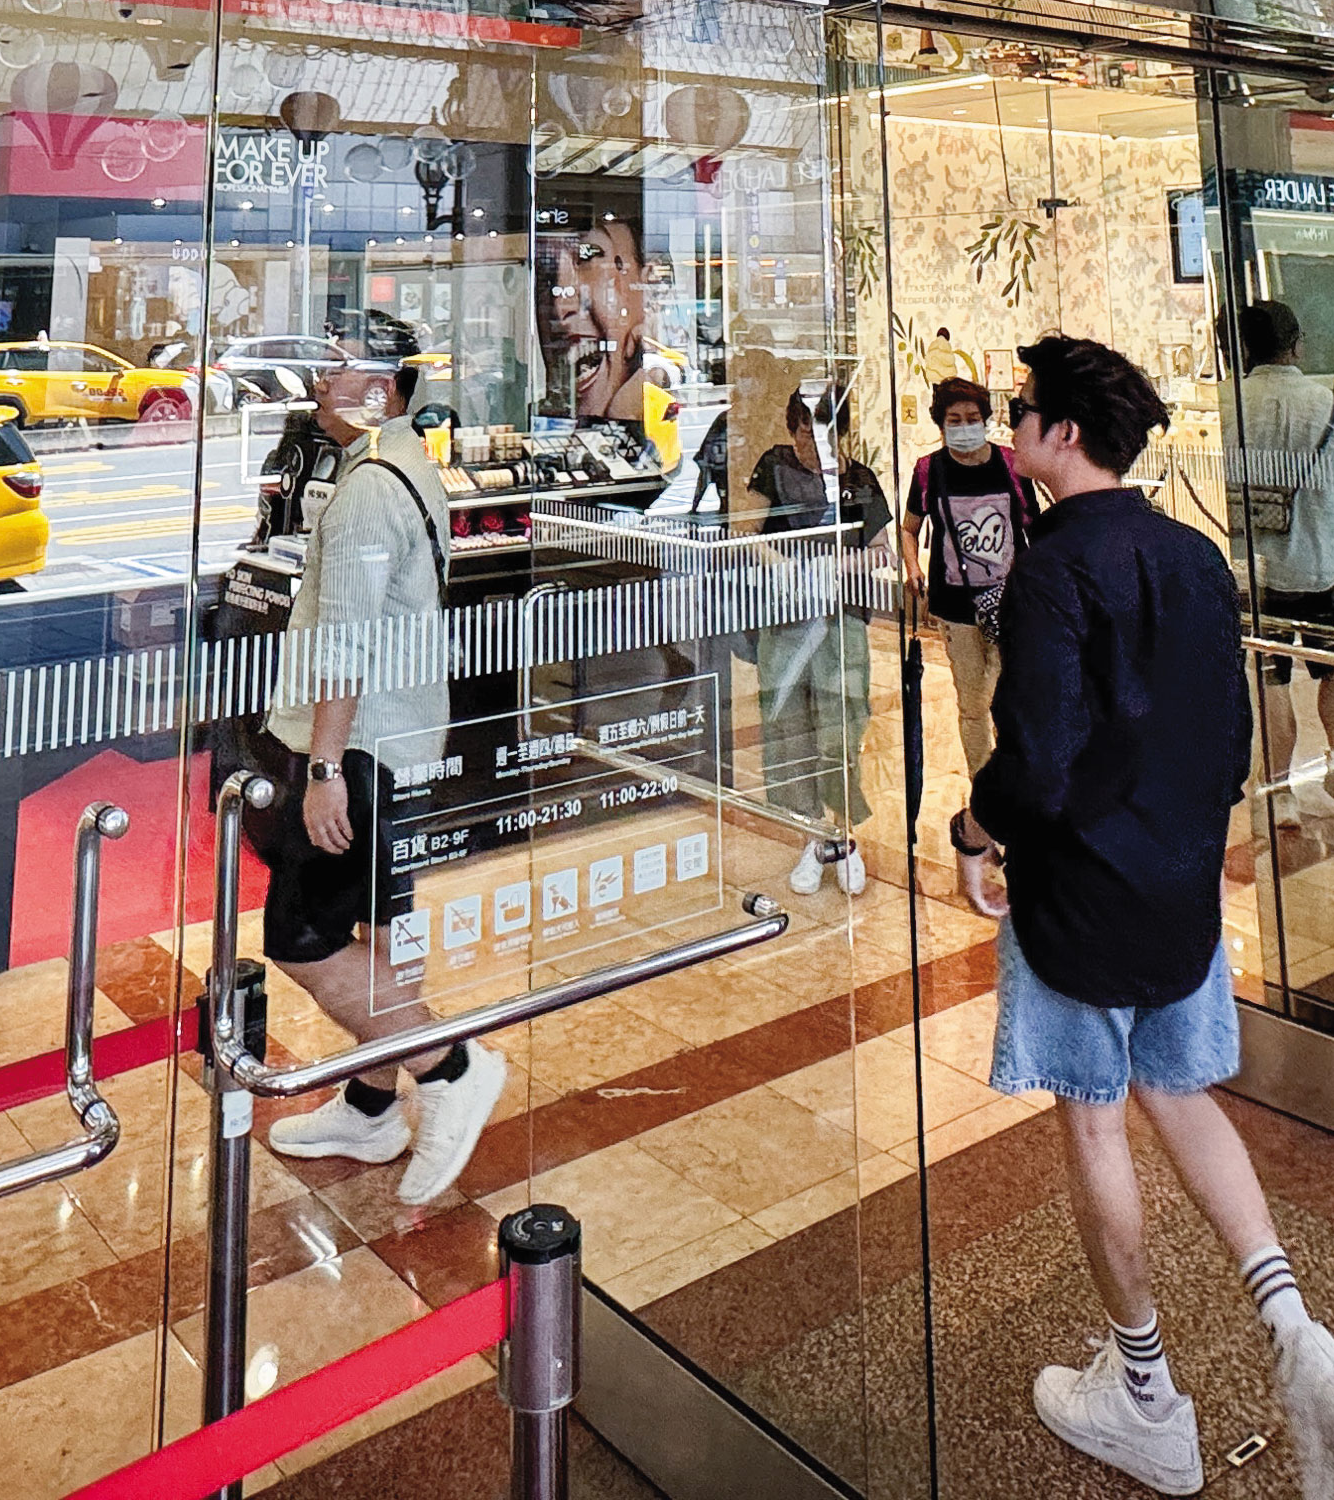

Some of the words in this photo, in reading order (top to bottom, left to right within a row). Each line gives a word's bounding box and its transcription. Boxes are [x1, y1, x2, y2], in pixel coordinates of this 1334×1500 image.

[215, 133, 292, 163] MAKE
[298, 139, 330, 165] UP
[214, 158, 265, 186] FOR
[270, 161, 329, 188] EVER
[599, 775, 679, 811] 11:00-22:00
[496, 799, 582, 836] 11:00-21:30
